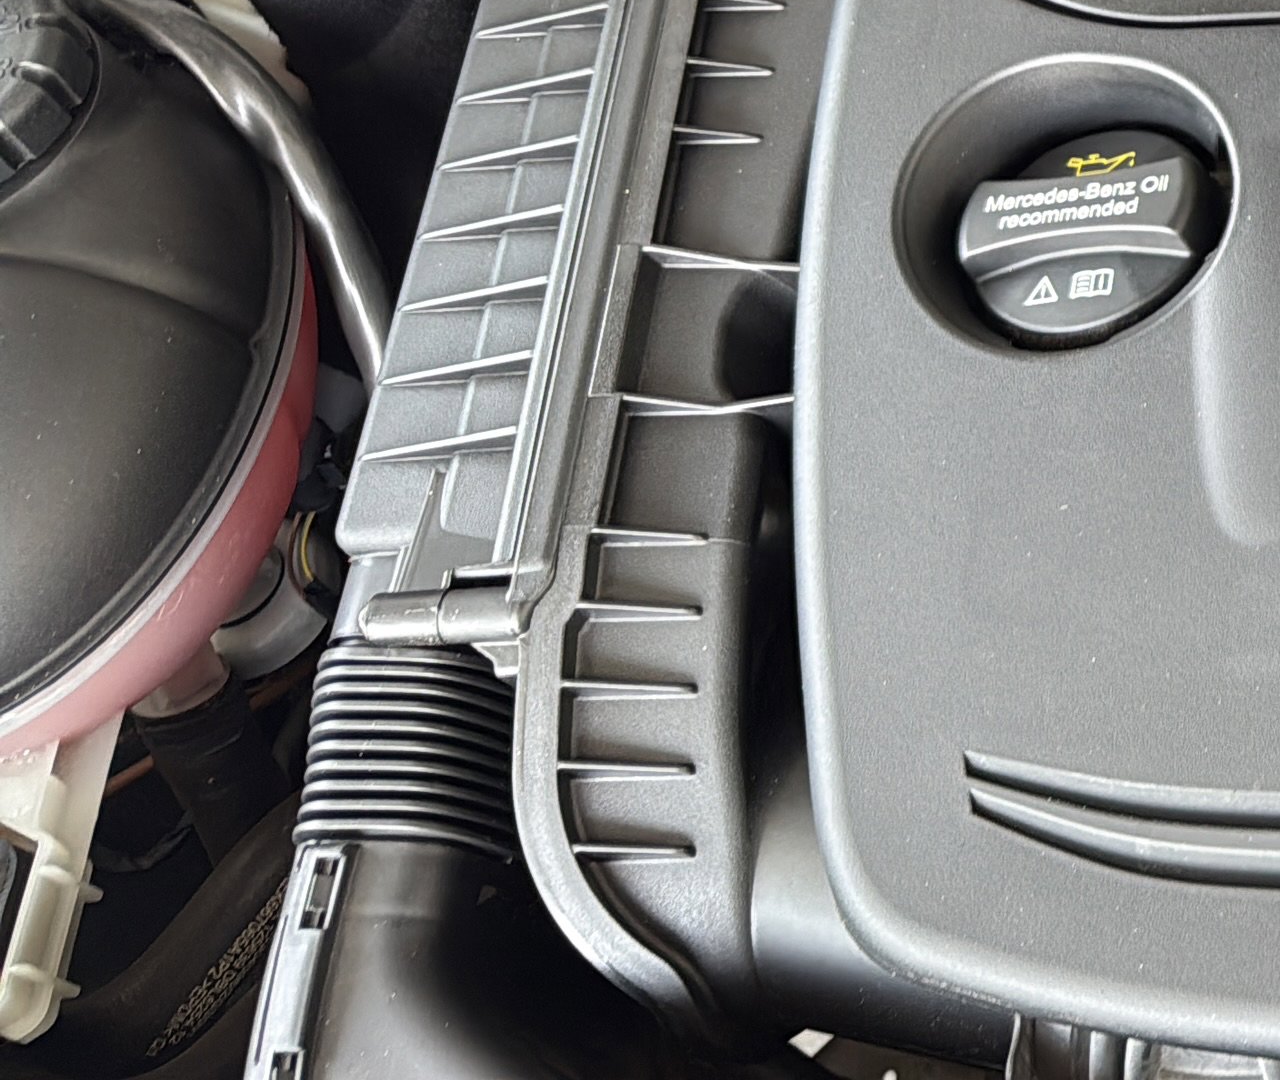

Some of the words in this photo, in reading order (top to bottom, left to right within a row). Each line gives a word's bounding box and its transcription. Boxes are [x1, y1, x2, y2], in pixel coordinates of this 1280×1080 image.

[984, 181, 1136, 213] Mercedes-Benz
[1140, 174, 1169, 194] Oil
[998, 196, 1139, 230] recommended
